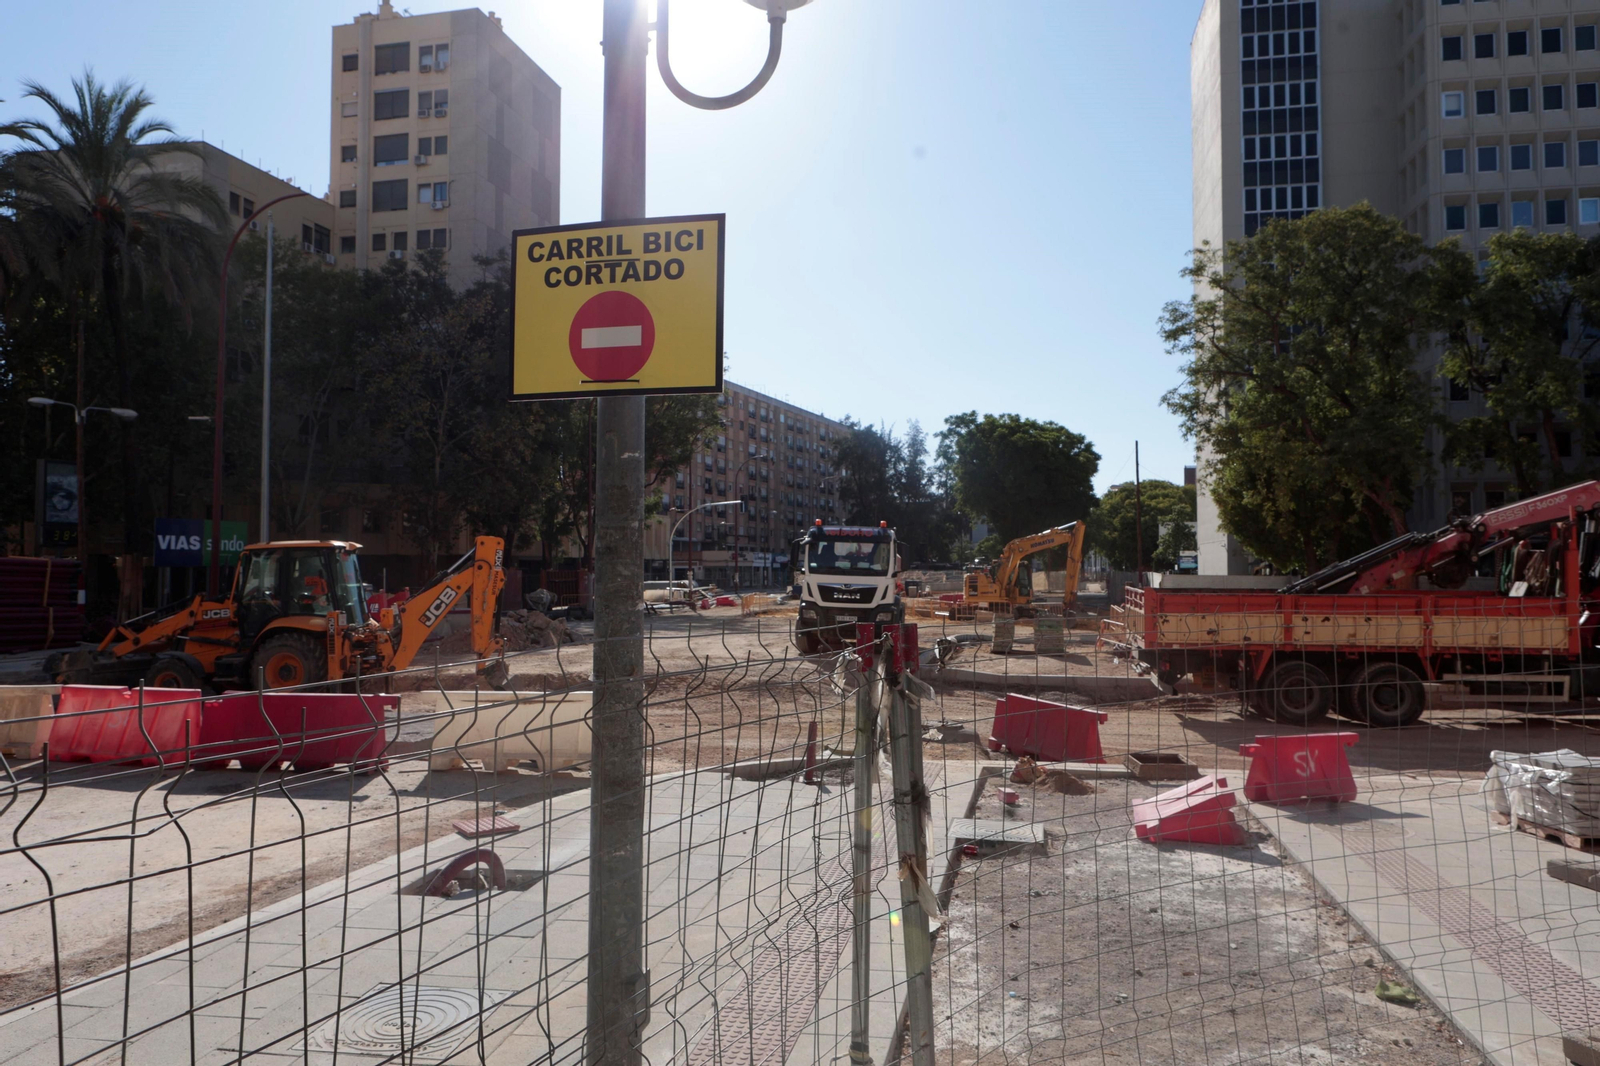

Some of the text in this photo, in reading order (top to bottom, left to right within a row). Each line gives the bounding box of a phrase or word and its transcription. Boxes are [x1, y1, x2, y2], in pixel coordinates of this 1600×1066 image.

[527, 229, 704, 263] CARRIL BICI
[543, 258, 685, 288] CORTADO
[1490, 494, 1568, 524] FASSI F360XP
[157, 534, 244, 551] VIAS sndo
[202, 608, 231, 619] JCB
[424, 587, 457, 627] JCB
